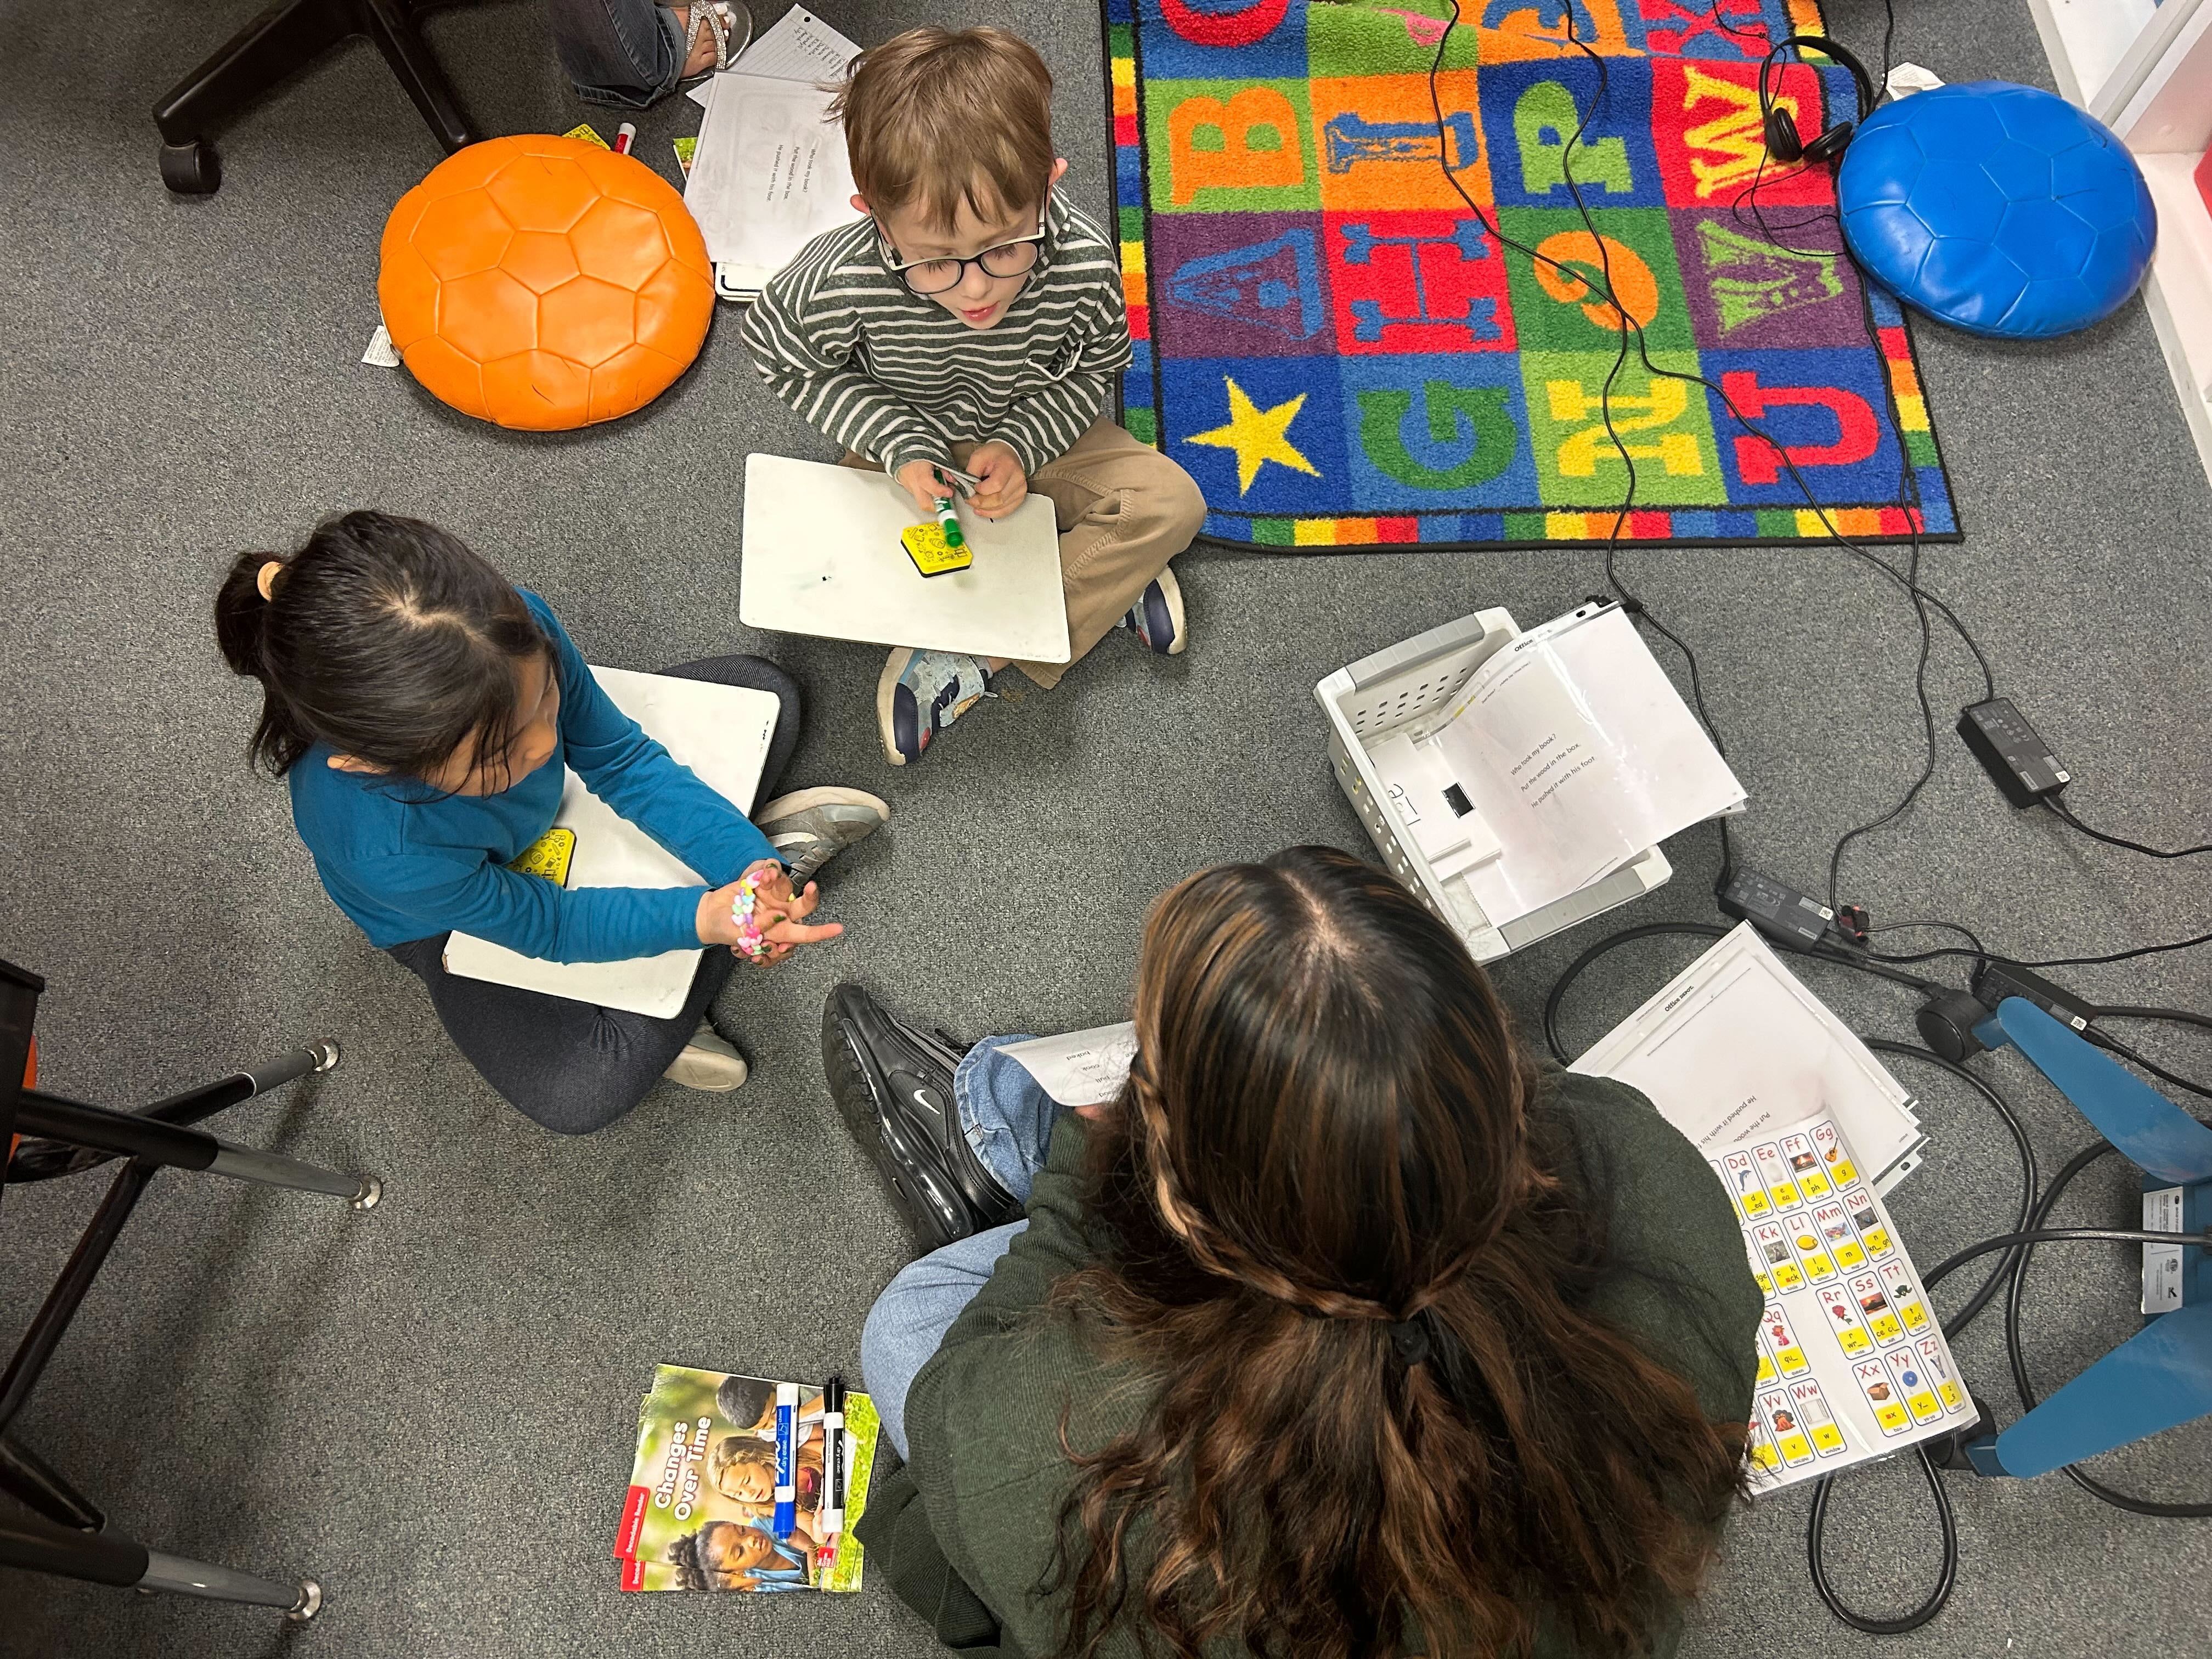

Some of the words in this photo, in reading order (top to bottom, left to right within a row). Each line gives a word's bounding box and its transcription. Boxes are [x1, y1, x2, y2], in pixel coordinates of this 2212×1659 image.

[1513, 81, 1633, 193] P
[1684, 66, 1801, 199] W
[1168, 86, 1304, 205] B
[1165, 228, 1324, 341] A
[1340, 219, 1503, 342] H
[1696, 218, 1843, 340] V
[1546, 377, 1704, 477] N
[1721, 370, 1883, 485] U
[1356, 380, 1519, 492] G
[1510, 764, 1522, 776] Who
[1521, 754, 1532, 766] took
[1532, 747, 1540, 757] my
[1538, 733, 1556, 750] book?
[1521, 783, 1529, 792] Put
[1528, 776, 1537, 785] the
[1536, 763, 1550, 778] wood
[1556, 752, 1566, 761] the
[1531, 800, 1539, 808] He
[1538, 786, 1554, 804] pushed
[1558, 772, 1571, 784] with
[1570, 766, 1581, 775] his
[1664, 997, 1680, 1012] Office
[1066, 1050, 1091, 1060] baked
[1746, 1095, 1757, 1104] He
[1727, 1101, 1747, 1123] pushed
[1759, 1111, 1770, 1122] Put
[1709, 1124, 1723, 1137] with
[1750, 1120, 1760, 1130] the
[1700, 1135, 1711, 1144] his
[1815, 1128, 1833, 1141] Gg
[1785, 1137, 1800, 1152] Ff
[1728, 1154, 1748, 1169] Dd
[1757, 1148, 1775, 1161] Ee
[1811, 1184, 1820, 1193] ph
[1751, 1193, 1756, 1201] d
[1847, 1194, 1867, 1210] Nn
[1817, 1207, 1842, 1222] Mm
[1790, 1216, 1804, 1231] Ll
[1758, 1226, 1779, 1240] Kk
[1882, 1238, 1890, 1248] gn
[1882, 1265, 1900, 1279] Tt
[1855, 1278, 1874, 1292] Ss
[1822, 1291, 1841, 1304] Rr
[1762, 1310, 1782, 1323] Qq
[1876, 1329, 1885, 1338] ce
[1920, 1340, 1938, 1355] Zz
[1889, 1353, 1909, 1368] Yy
[1857, 1364, 1880, 1379] Xx
[1791, 1384, 1818, 1400] Ww
[1763, 1395, 1781, 1409] Vv
[686, 1416, 712, 1463] Time
[654, 1421, 688, 1509] Changes
[674, 1469, 699, 1521] Over
[625, 1516, 640, 1553] Decodable
[634, 1492, 645, 1518] Reader
